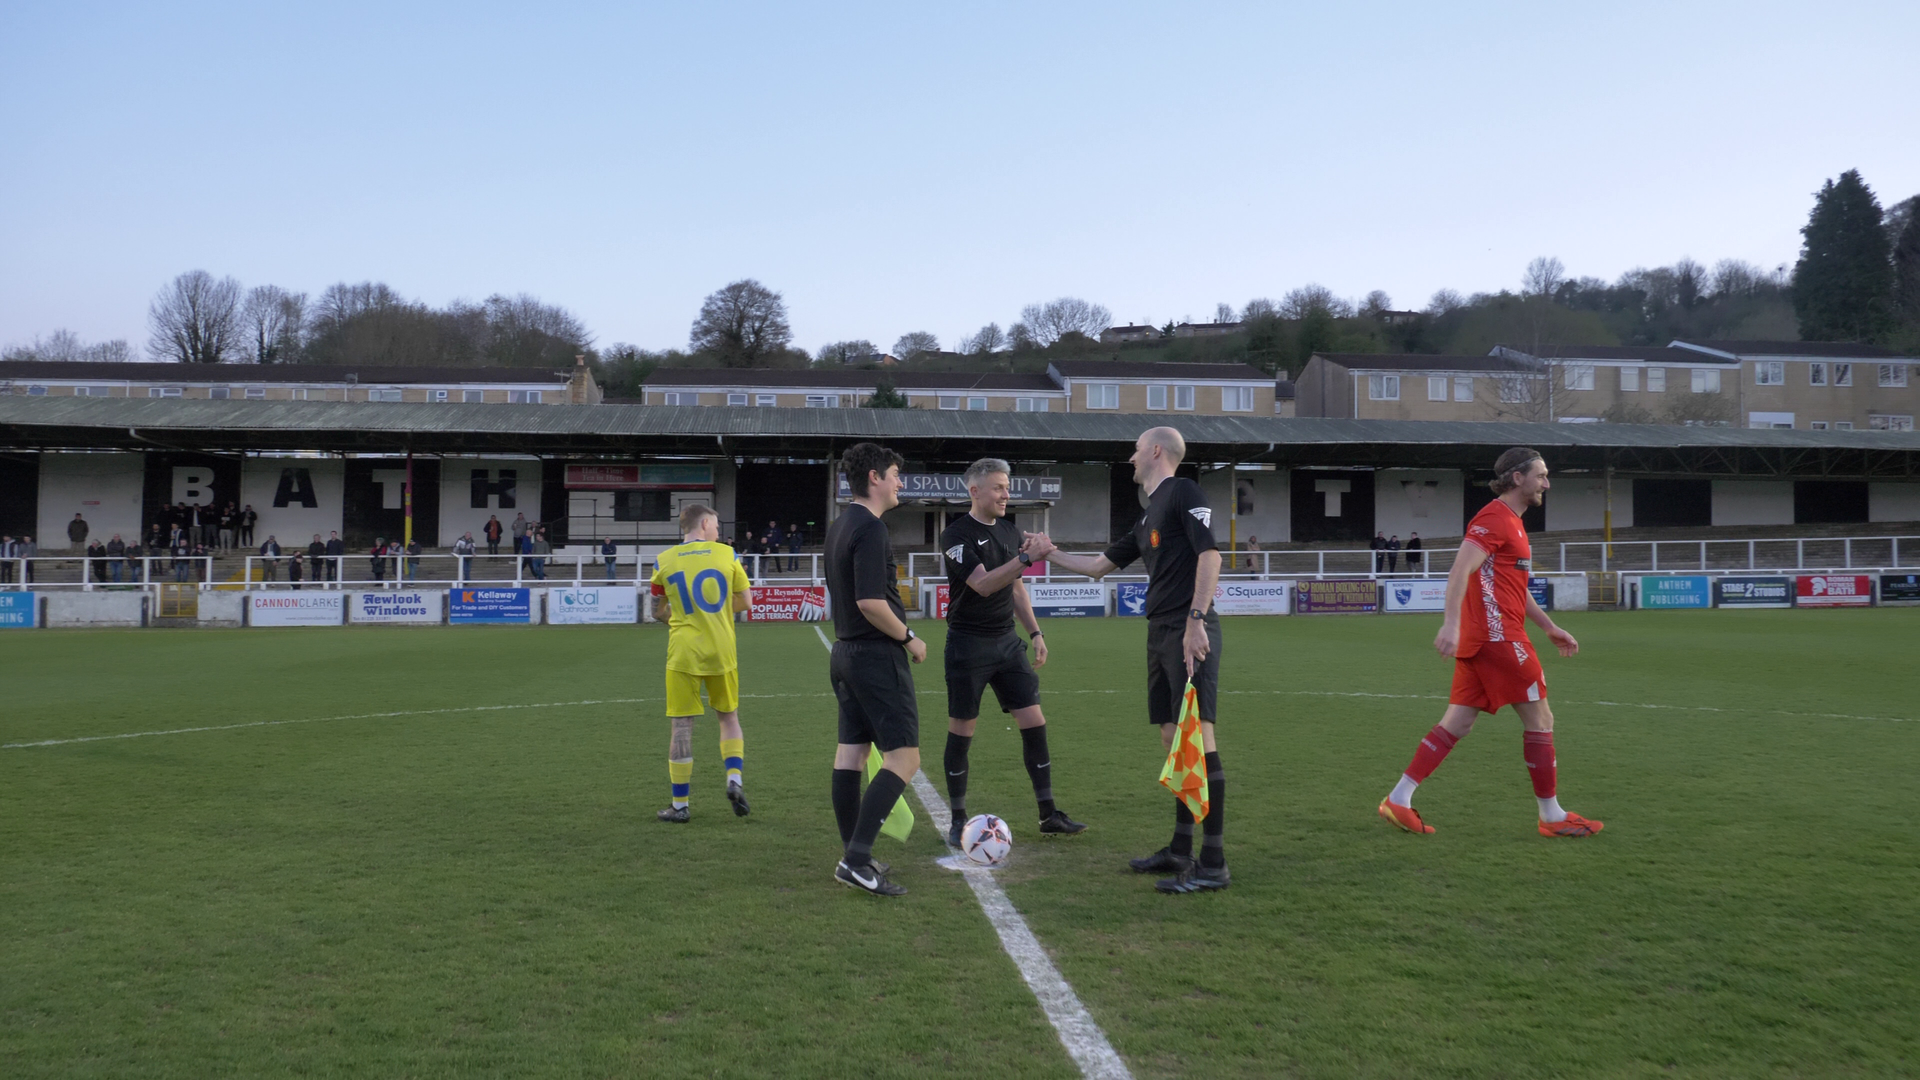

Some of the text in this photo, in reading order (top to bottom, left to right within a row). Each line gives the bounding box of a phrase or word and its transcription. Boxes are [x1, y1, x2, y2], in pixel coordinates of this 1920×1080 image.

[911, 476, 942, 490] SPA
[1041, 484, 1060, 493] BSU
[1310, 582, 1376, 593] ROMAN BOXING GYM
[1658, 581, 1692, 590] ANTHEM
[1721, 583, 1786, 598] STAGE 2 STUDIOS
[477, 591, 517, 601] Kellaway
[666, 568, 728, 616] 10
[773, 589, 804, 598] Reynolds
[1034, 588, 1101, 597] TWERTON PARK
[1226, 586, 1283, 599] CSquared
[1827, 587, 1855, 595] BATH
[255, 597, 339, 608] CANNONCLARKE
[362, 593, 422, 605] Newlook
[554, 589, 599, 606] Total
[1650, 595, 1701, 605] PUBLISHING
[363, 605, 427, 616] Windows
[751, 604, 798, 613] POPULAR
[751, 612, 794, 620] SIDE TERRACE
